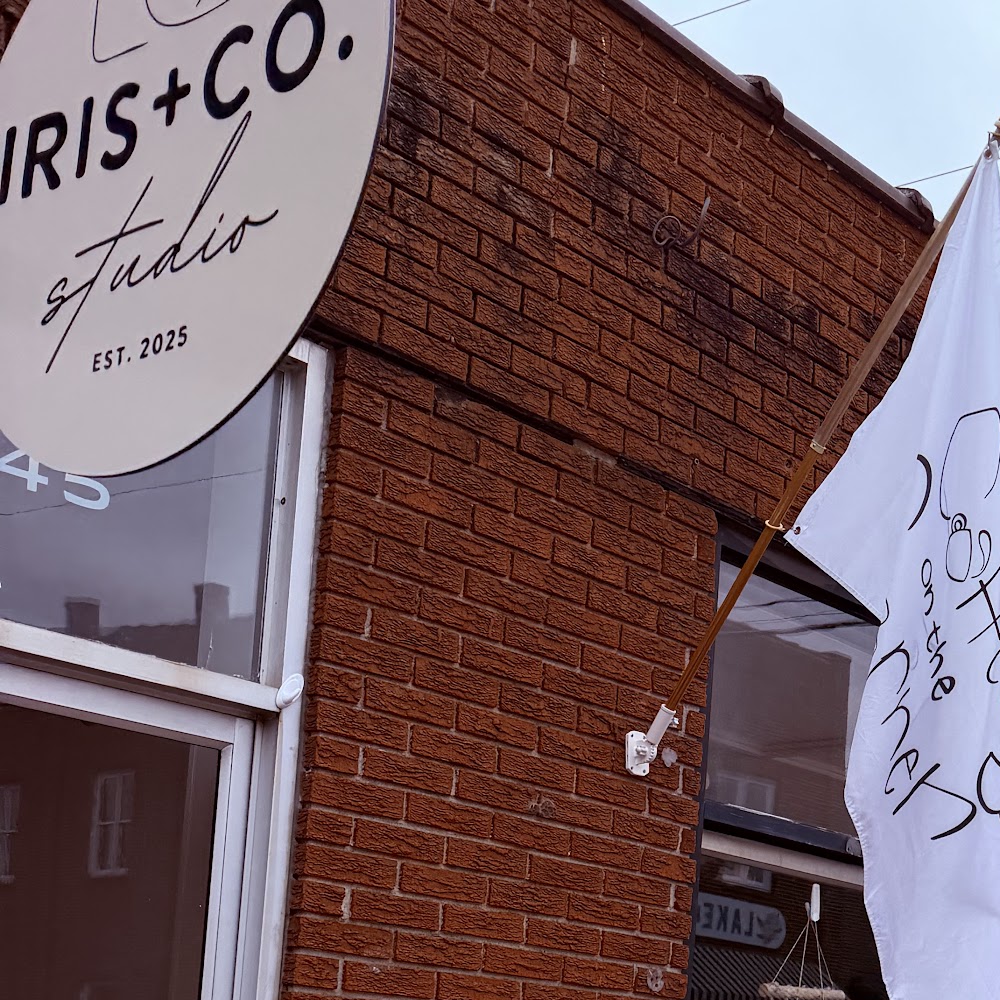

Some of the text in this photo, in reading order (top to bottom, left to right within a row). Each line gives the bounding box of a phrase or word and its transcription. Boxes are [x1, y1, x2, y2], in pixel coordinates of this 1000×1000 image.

[41, 110, 280, 374] studio
[92, 325, 189, 373] EST. 2025
[926, 620, 956, 701] the
